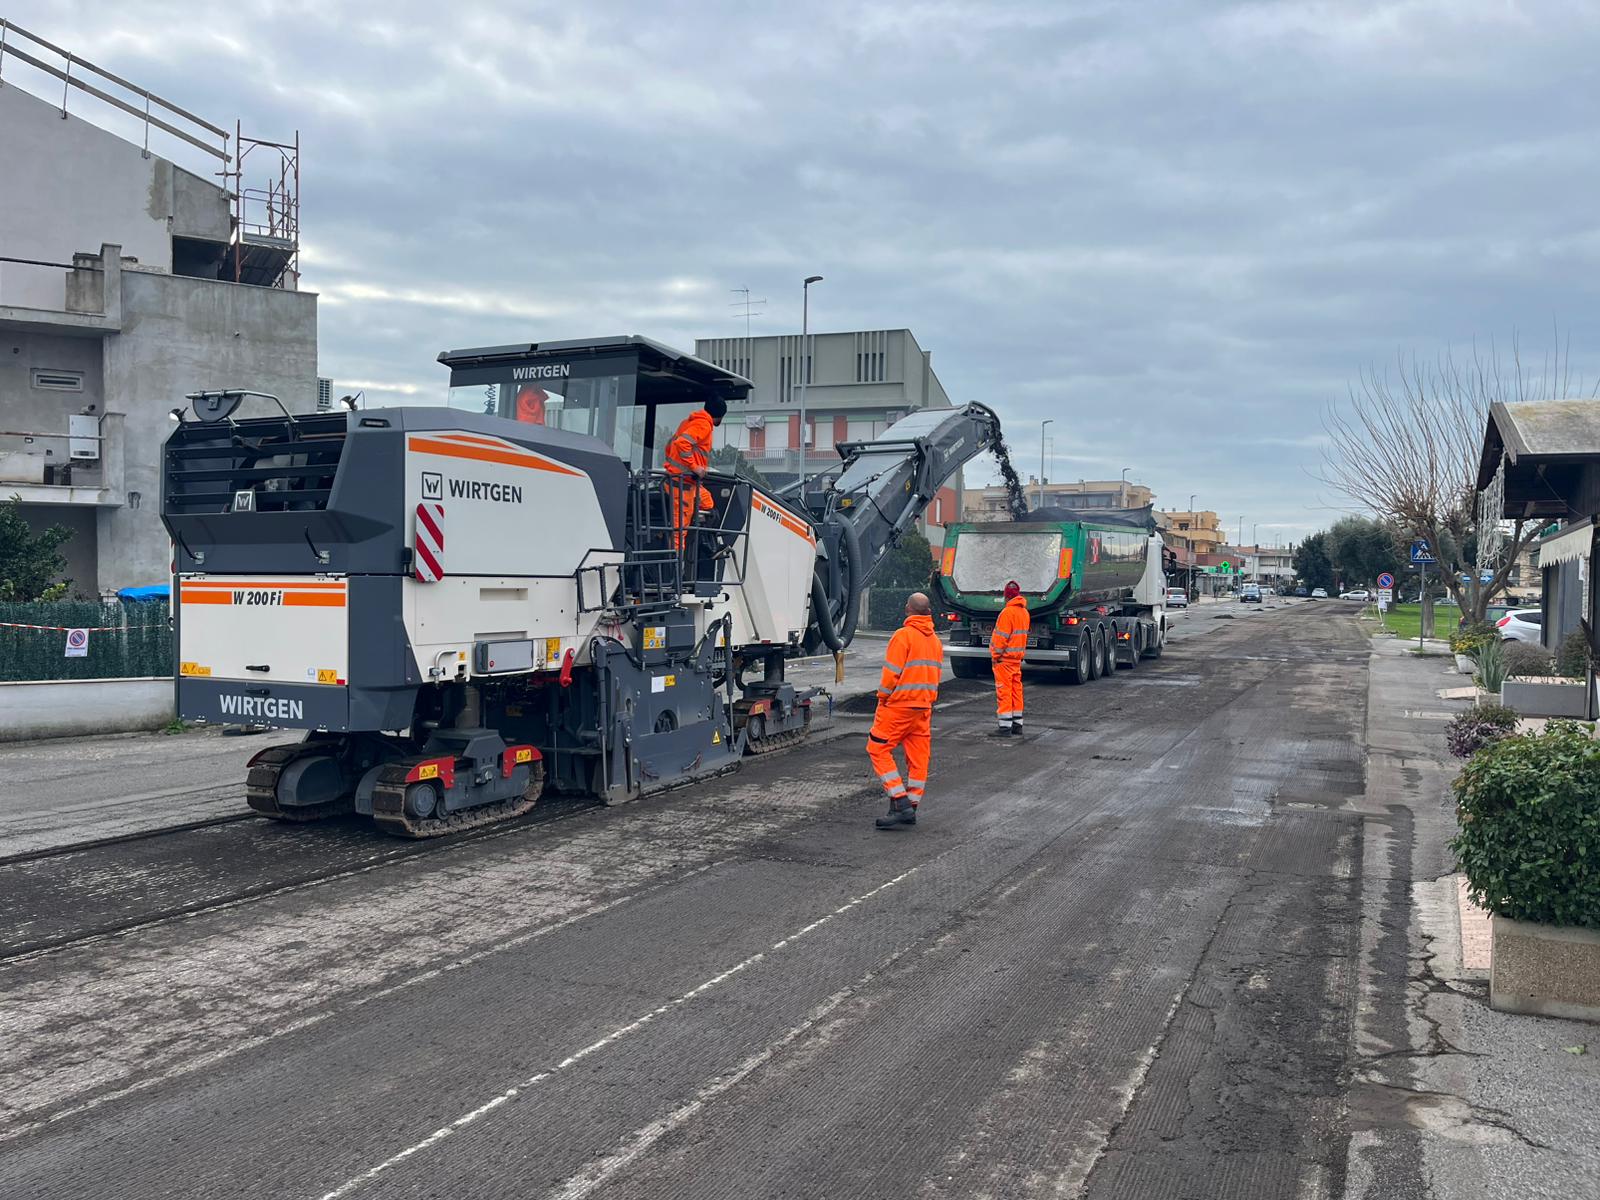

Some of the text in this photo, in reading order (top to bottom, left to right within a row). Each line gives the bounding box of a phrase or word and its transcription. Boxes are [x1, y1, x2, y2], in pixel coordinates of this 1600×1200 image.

[512, 364, 570, 380] WIRTGEN
[424, 477, 522, 504] W WIRTGEN
[233, 590, 282, 606] W 200Fi
[219, 694, 303, 720] WIRTGEN
